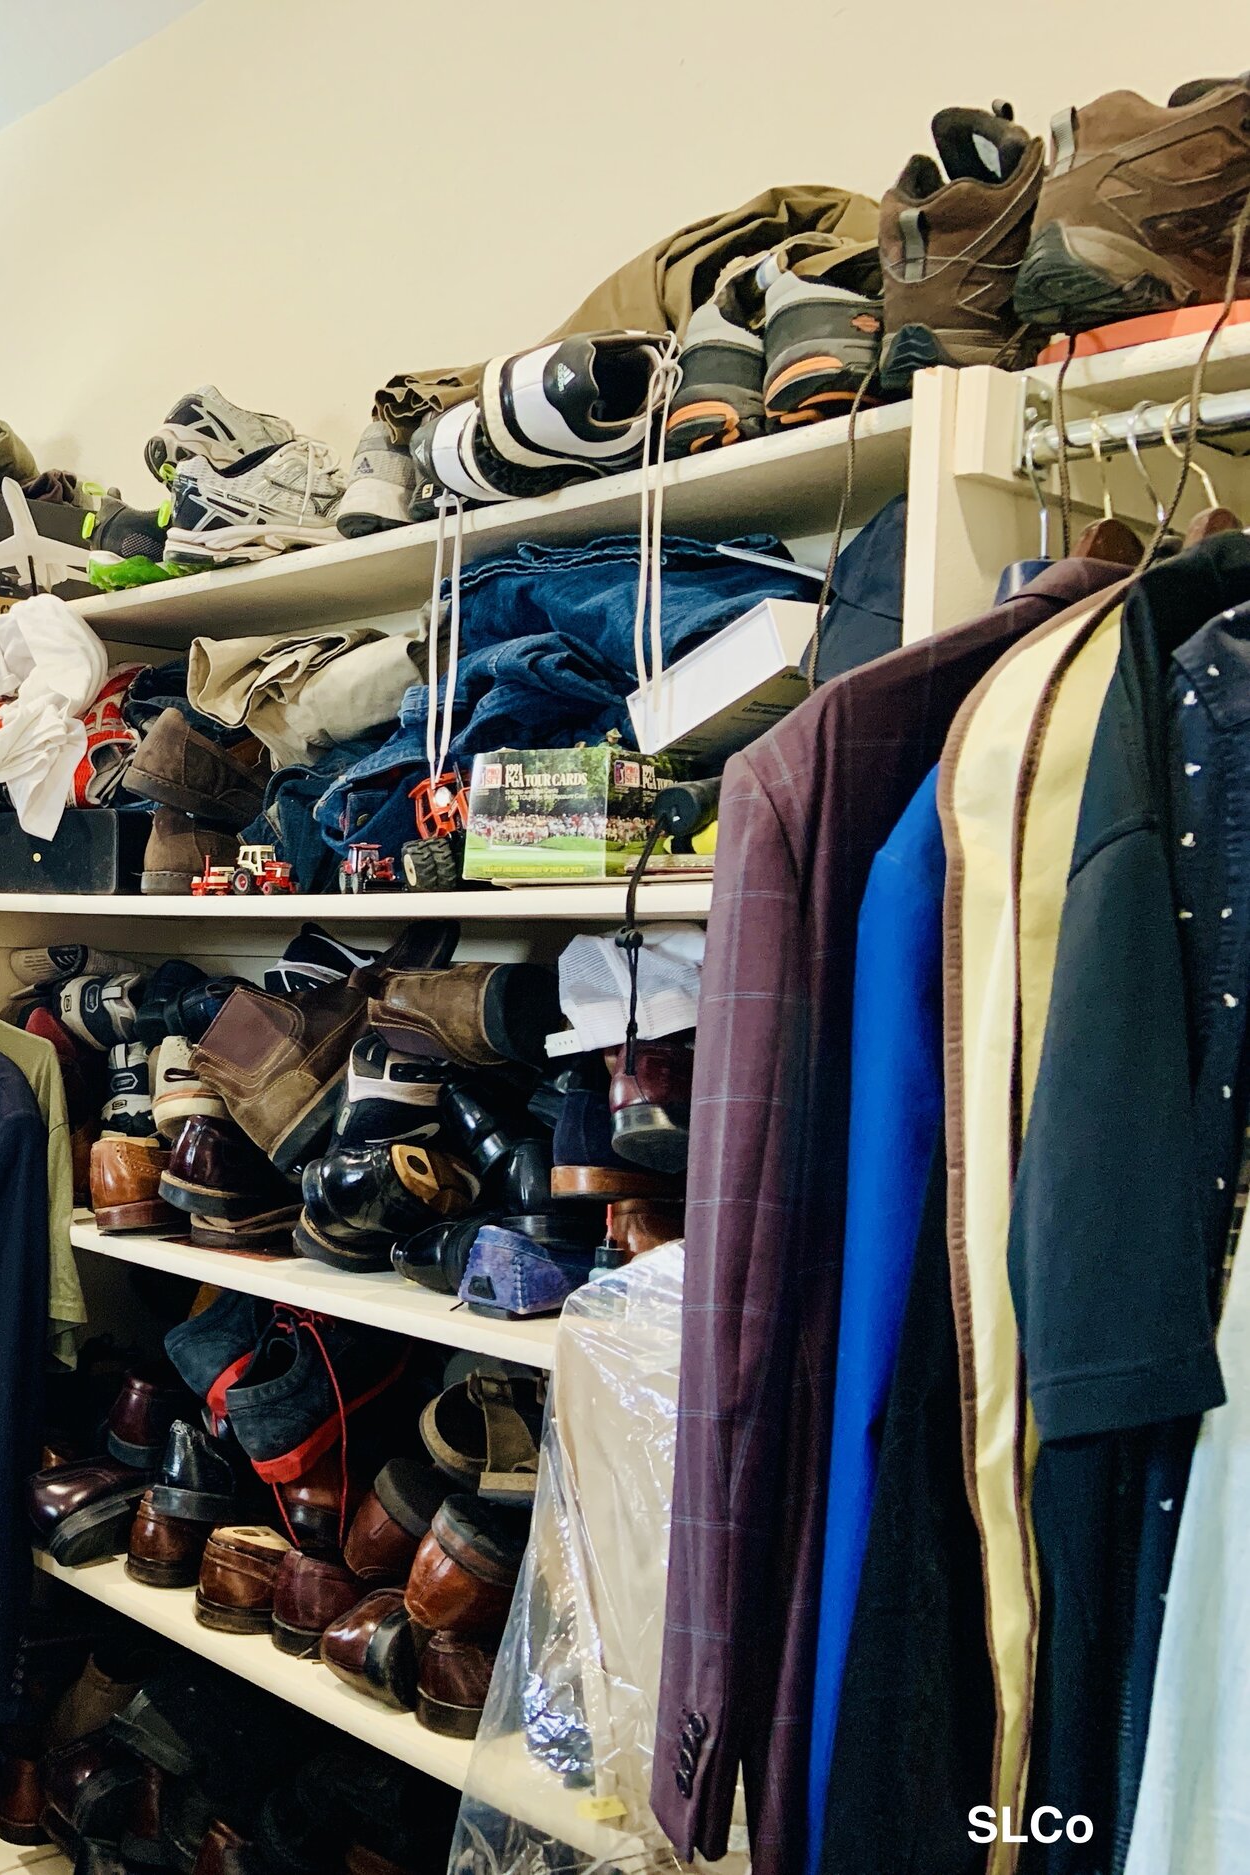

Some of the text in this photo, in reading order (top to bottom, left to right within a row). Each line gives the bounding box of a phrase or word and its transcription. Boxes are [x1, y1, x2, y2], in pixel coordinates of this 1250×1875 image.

[486, 767, 500, 776] PRO
[505, 763, 523, 775] 1991
[625, 765, 639, 775] PRO
[486, 776, 501, 785] SET
[505, 772, 588, 788] PGA TOUR CARDS
[625, 775, 638, 784] SET
